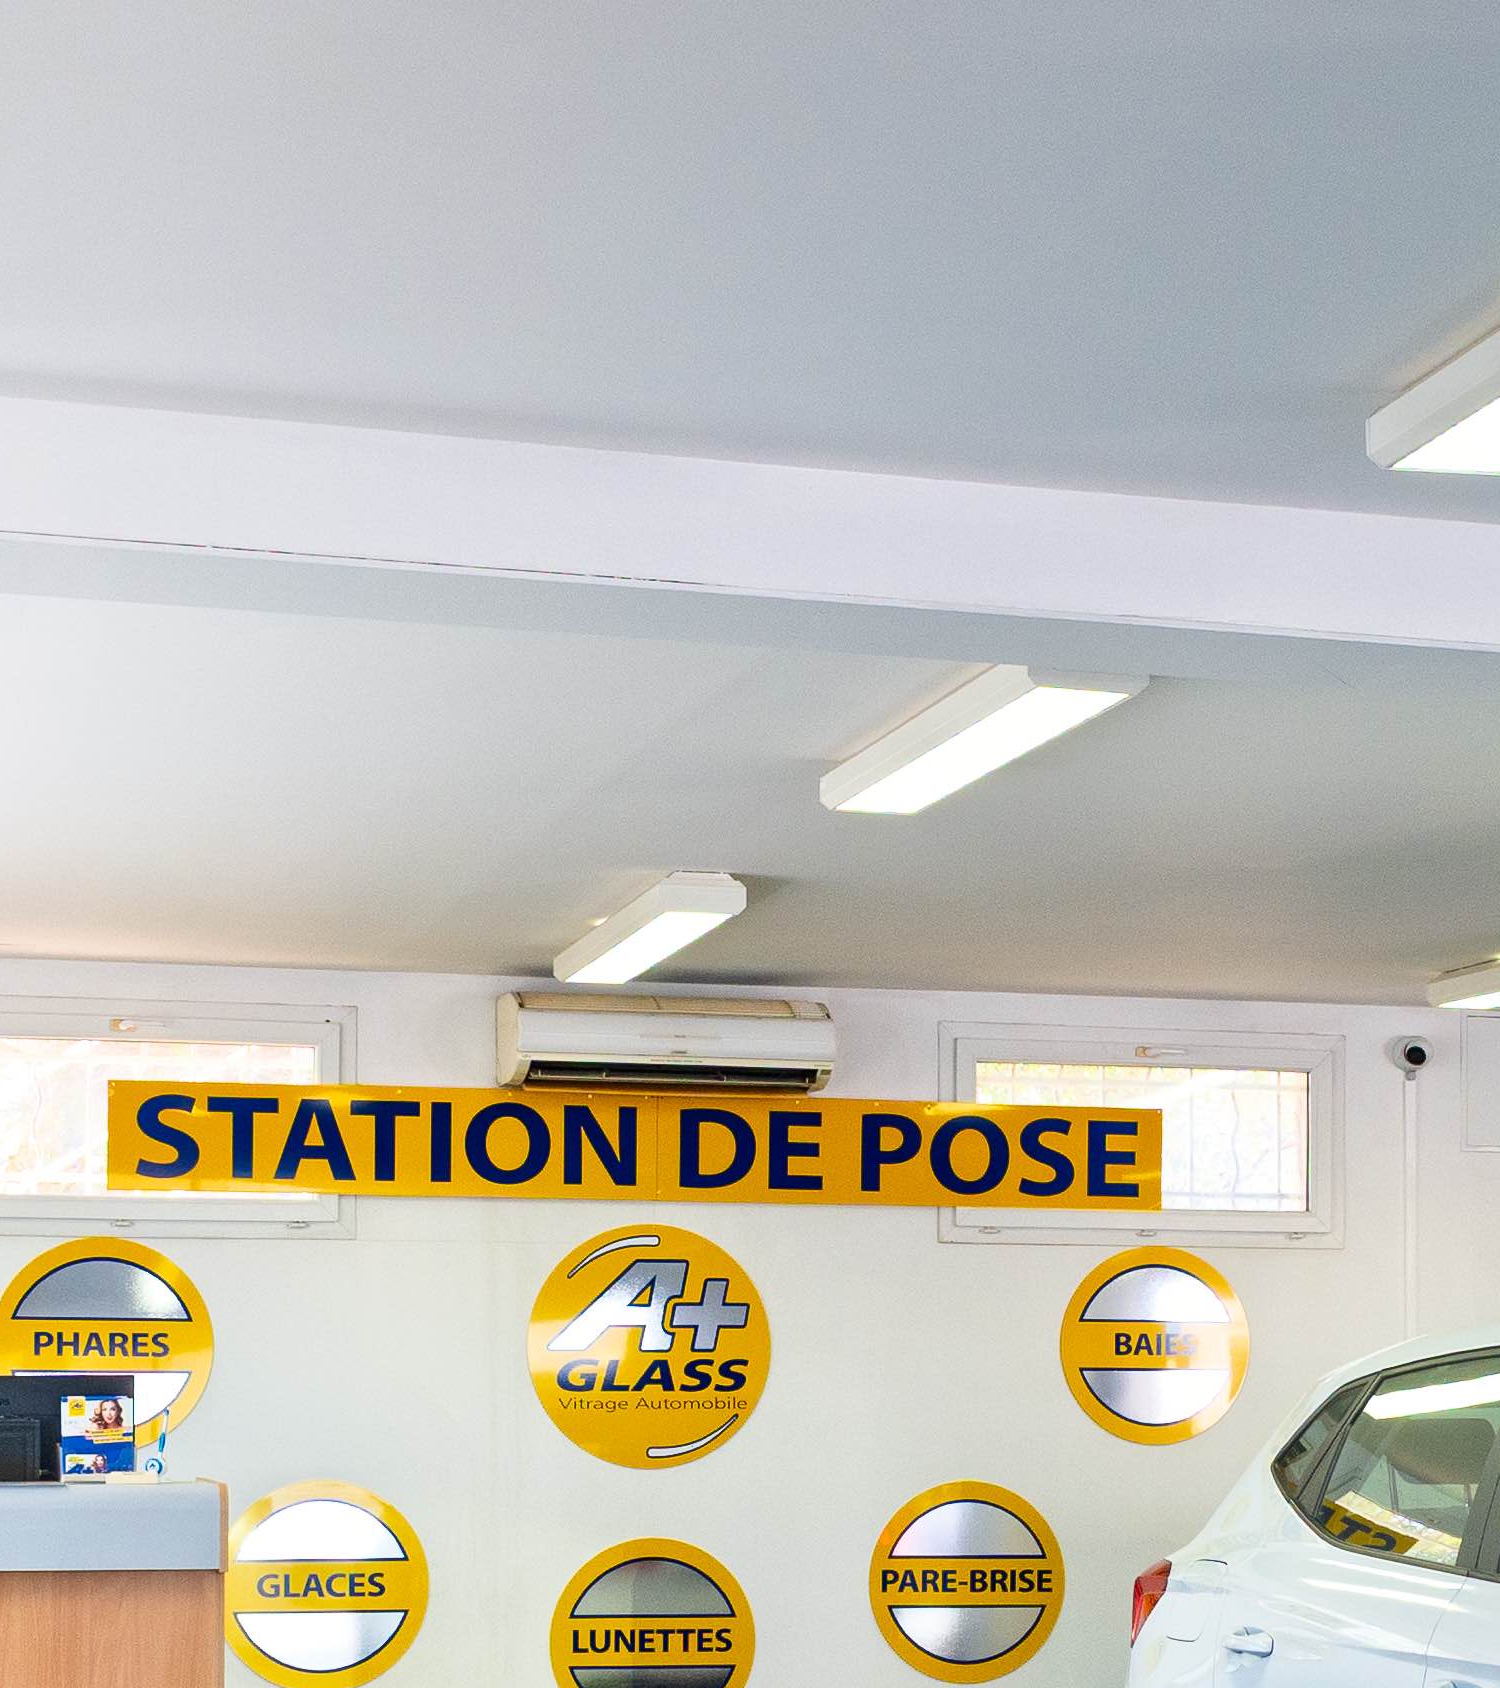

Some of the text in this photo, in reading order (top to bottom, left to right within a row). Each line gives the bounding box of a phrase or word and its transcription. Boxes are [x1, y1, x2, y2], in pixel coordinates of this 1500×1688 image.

[135, 1093, 1140, 1198] STATION DE POSE
[33, 1331, 169, 1357] PHARES
[1115, 1332, 1196, 1356] BAIES
[556, 1359, 749, 1392] GLASS
[558, 1397, 748, 1413] Vitrage Automobile
[256, 1572, 386, 1598] GLACES
[881, 1568, 1053, 1593] PARE-BRISE
[572, 1628, 733, 1654] LUNETTES
